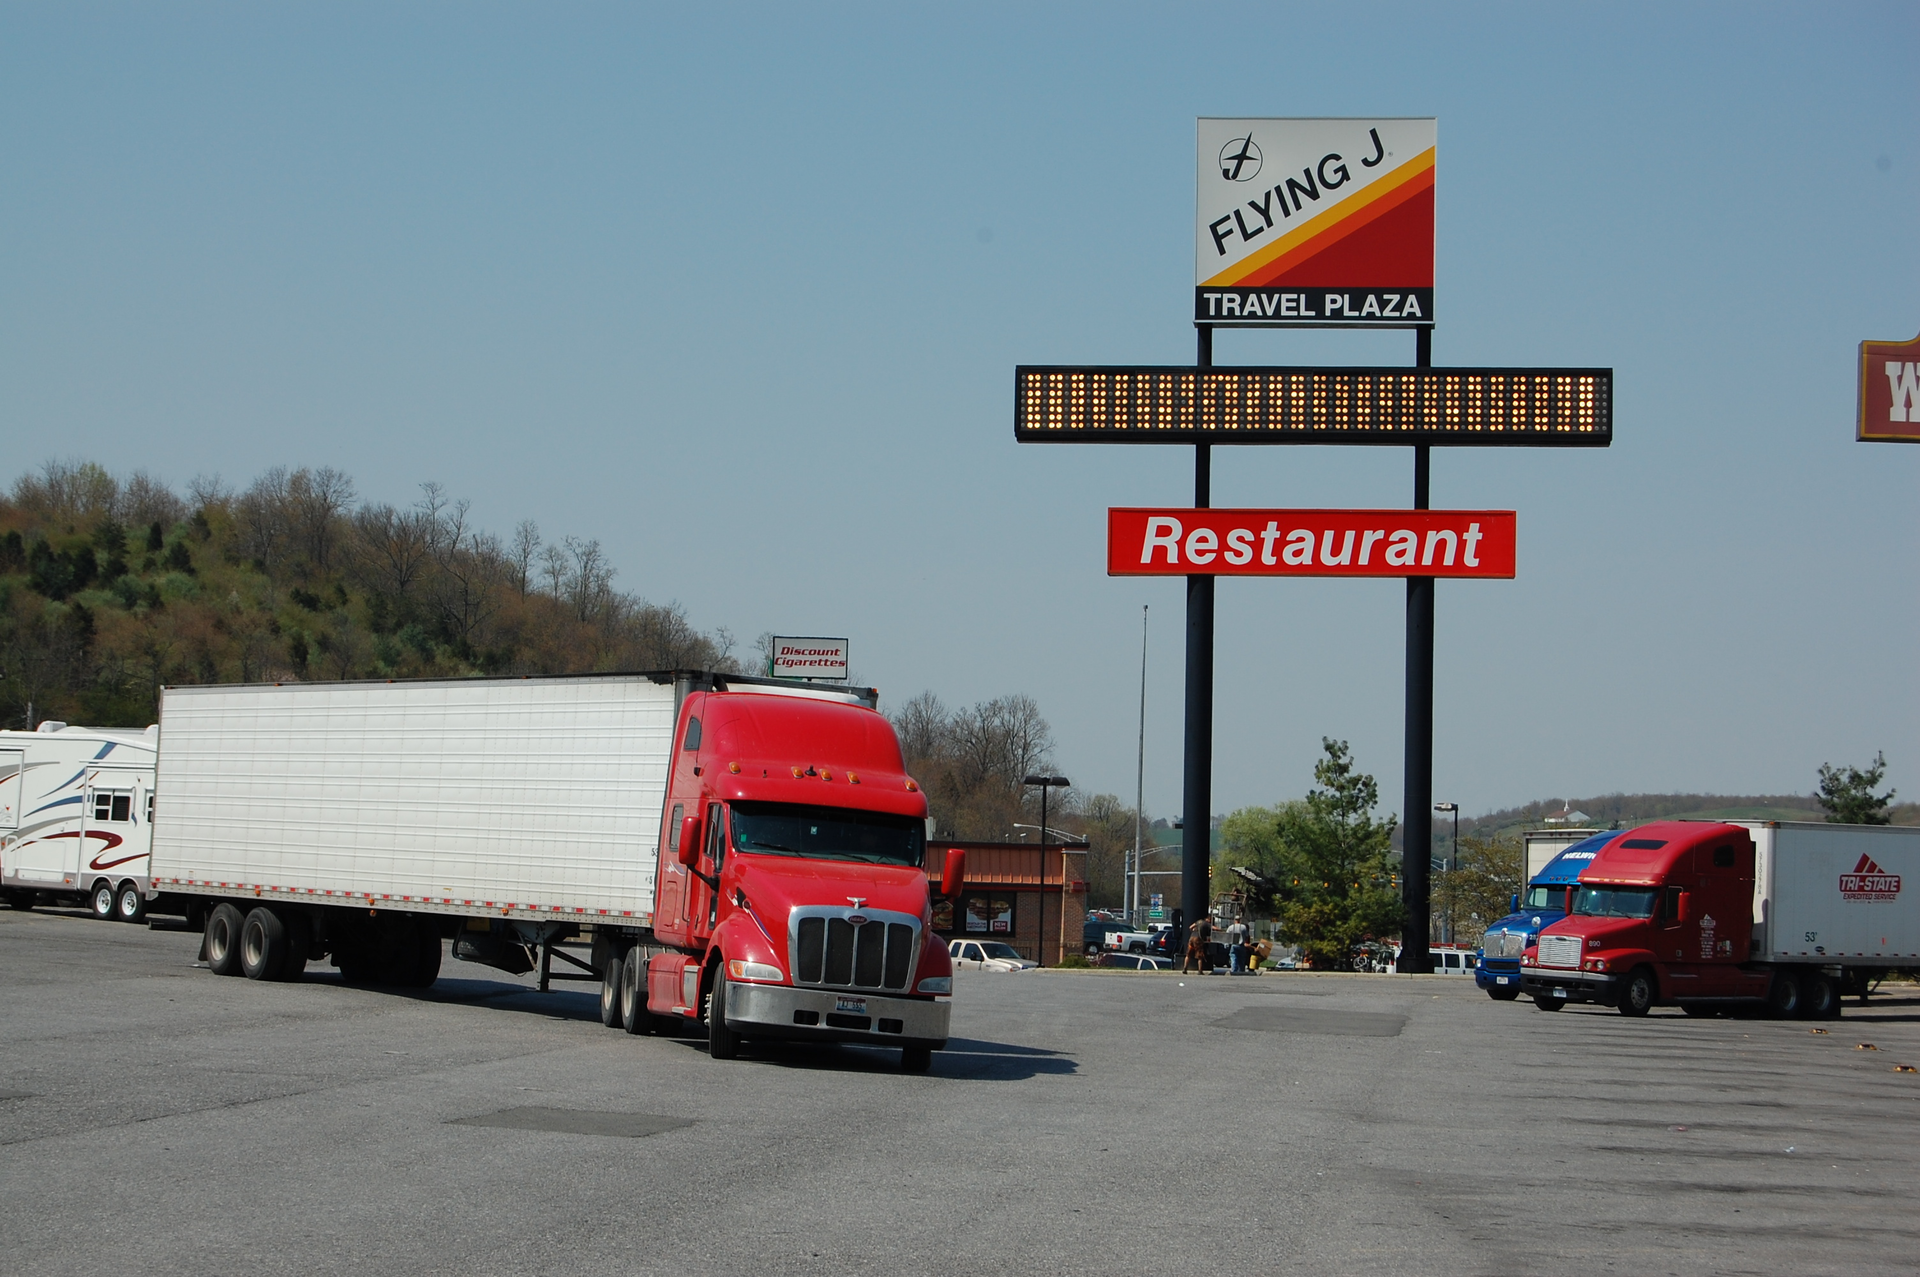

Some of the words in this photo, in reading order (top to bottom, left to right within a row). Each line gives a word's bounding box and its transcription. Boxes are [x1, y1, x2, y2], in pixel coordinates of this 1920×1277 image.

[1209, 153, 1351, 256] FLYING
[1361, 127, 1385, 168] J
[1203, 293, 1316, 316] TRAVEL
[1325, 294, 1422, 317] PLAZA
[1140, 516, 1483, 567] Restaurant
[780, 646, 842, 657] Discount
[774, 656, 847, 669] Cigarettes
[1840, 876, 1899, 891] TRI-STATE
